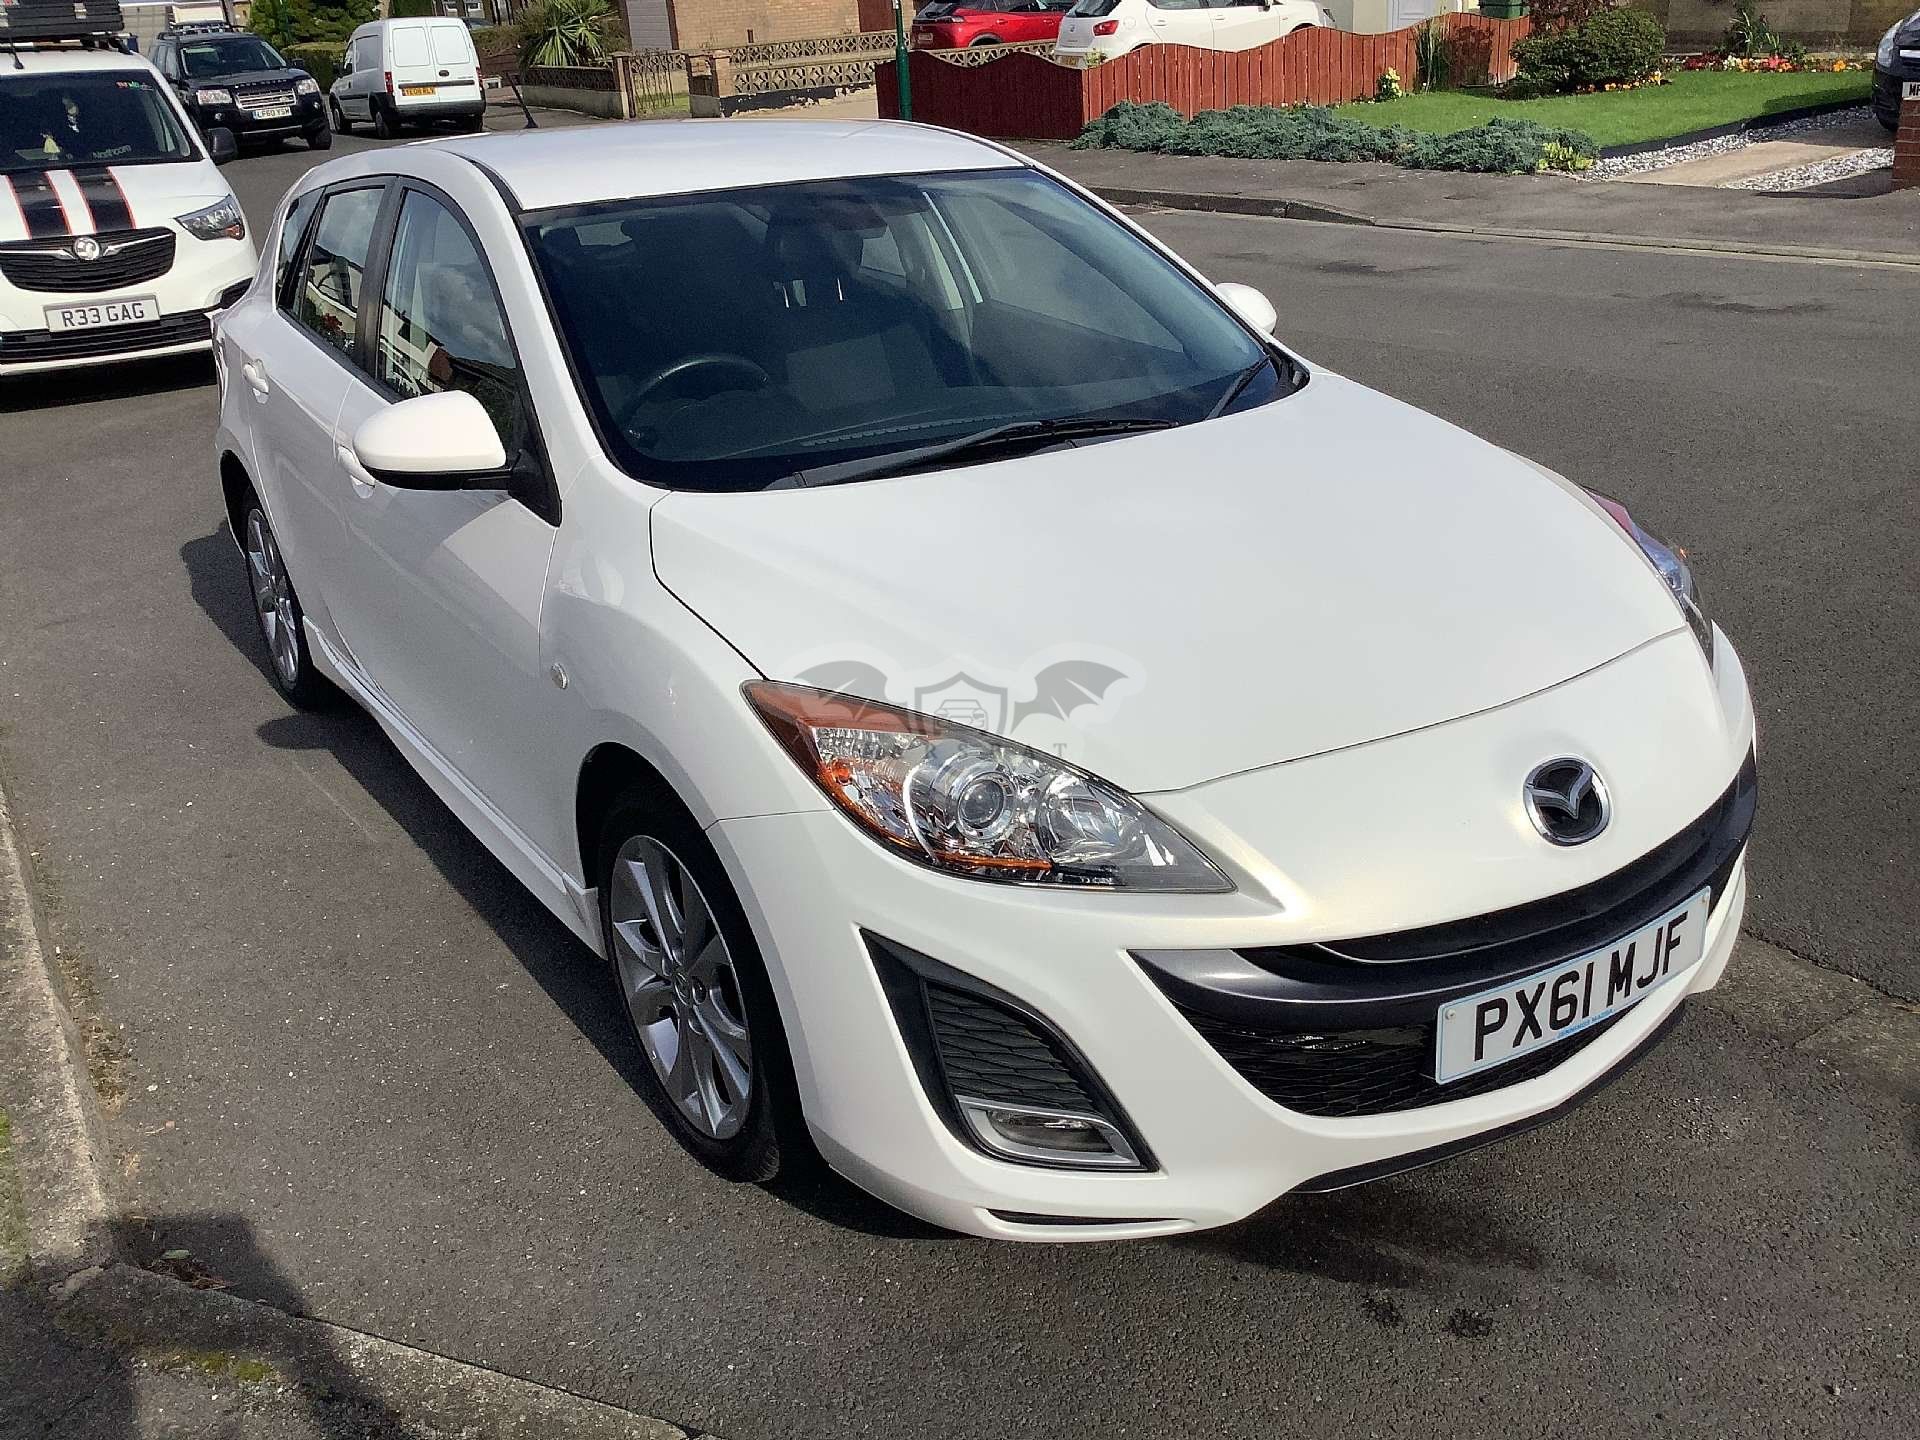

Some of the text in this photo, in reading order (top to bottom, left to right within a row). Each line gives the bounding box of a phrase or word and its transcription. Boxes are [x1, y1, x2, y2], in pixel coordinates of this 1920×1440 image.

[61, 303, 144, 327] R33 GAG
[1474, 910, 1688, 1062] PX61 MJF
